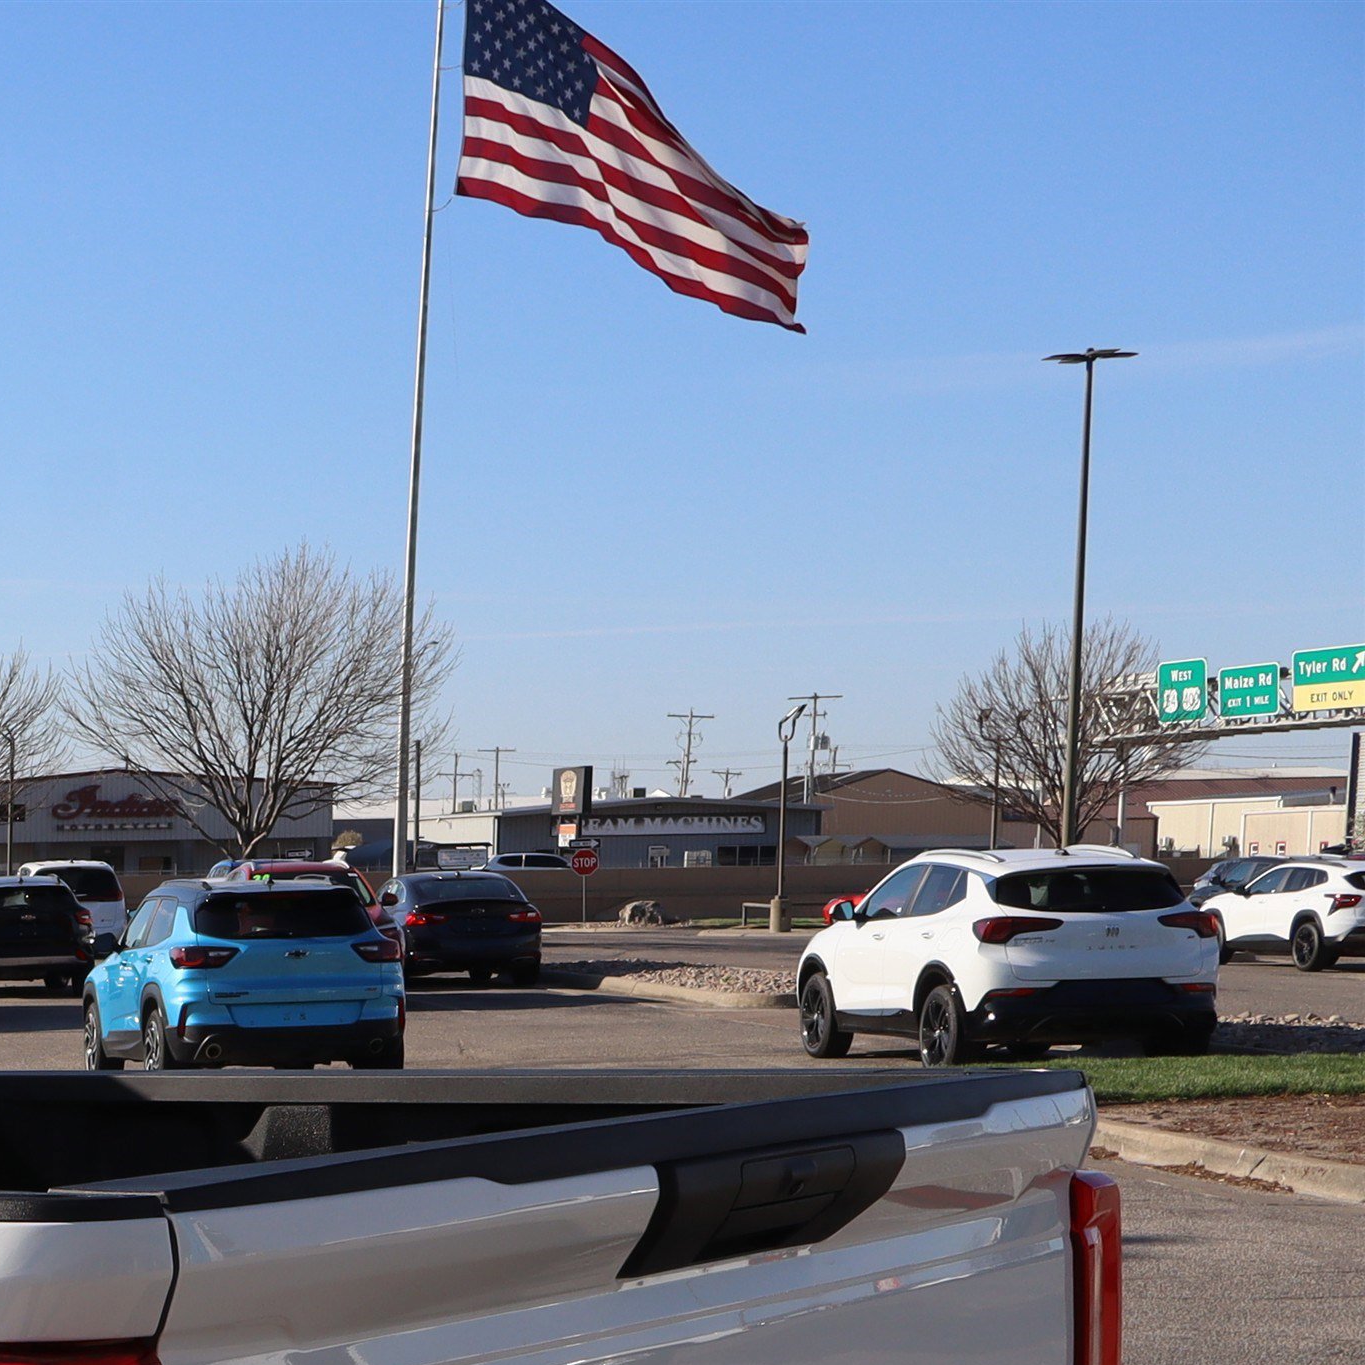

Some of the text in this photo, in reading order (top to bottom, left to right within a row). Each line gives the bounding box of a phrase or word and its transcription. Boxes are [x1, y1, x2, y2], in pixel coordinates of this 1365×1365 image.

[1299, 657, 1347, 677] Tyler Rd
[1171, 670, 1192, 681] WEST
[1224, 673, 1272, 690] Maize Rd
[1310, 690, 1354, 703] EXIT ONLY
[1227, 698, 1242, 708] EXIT
[57, 822, 174, 832] MOTORCYCLE
[643, 816, 763, 830] MACHINES
[573, 857, 597, 868] STOP
